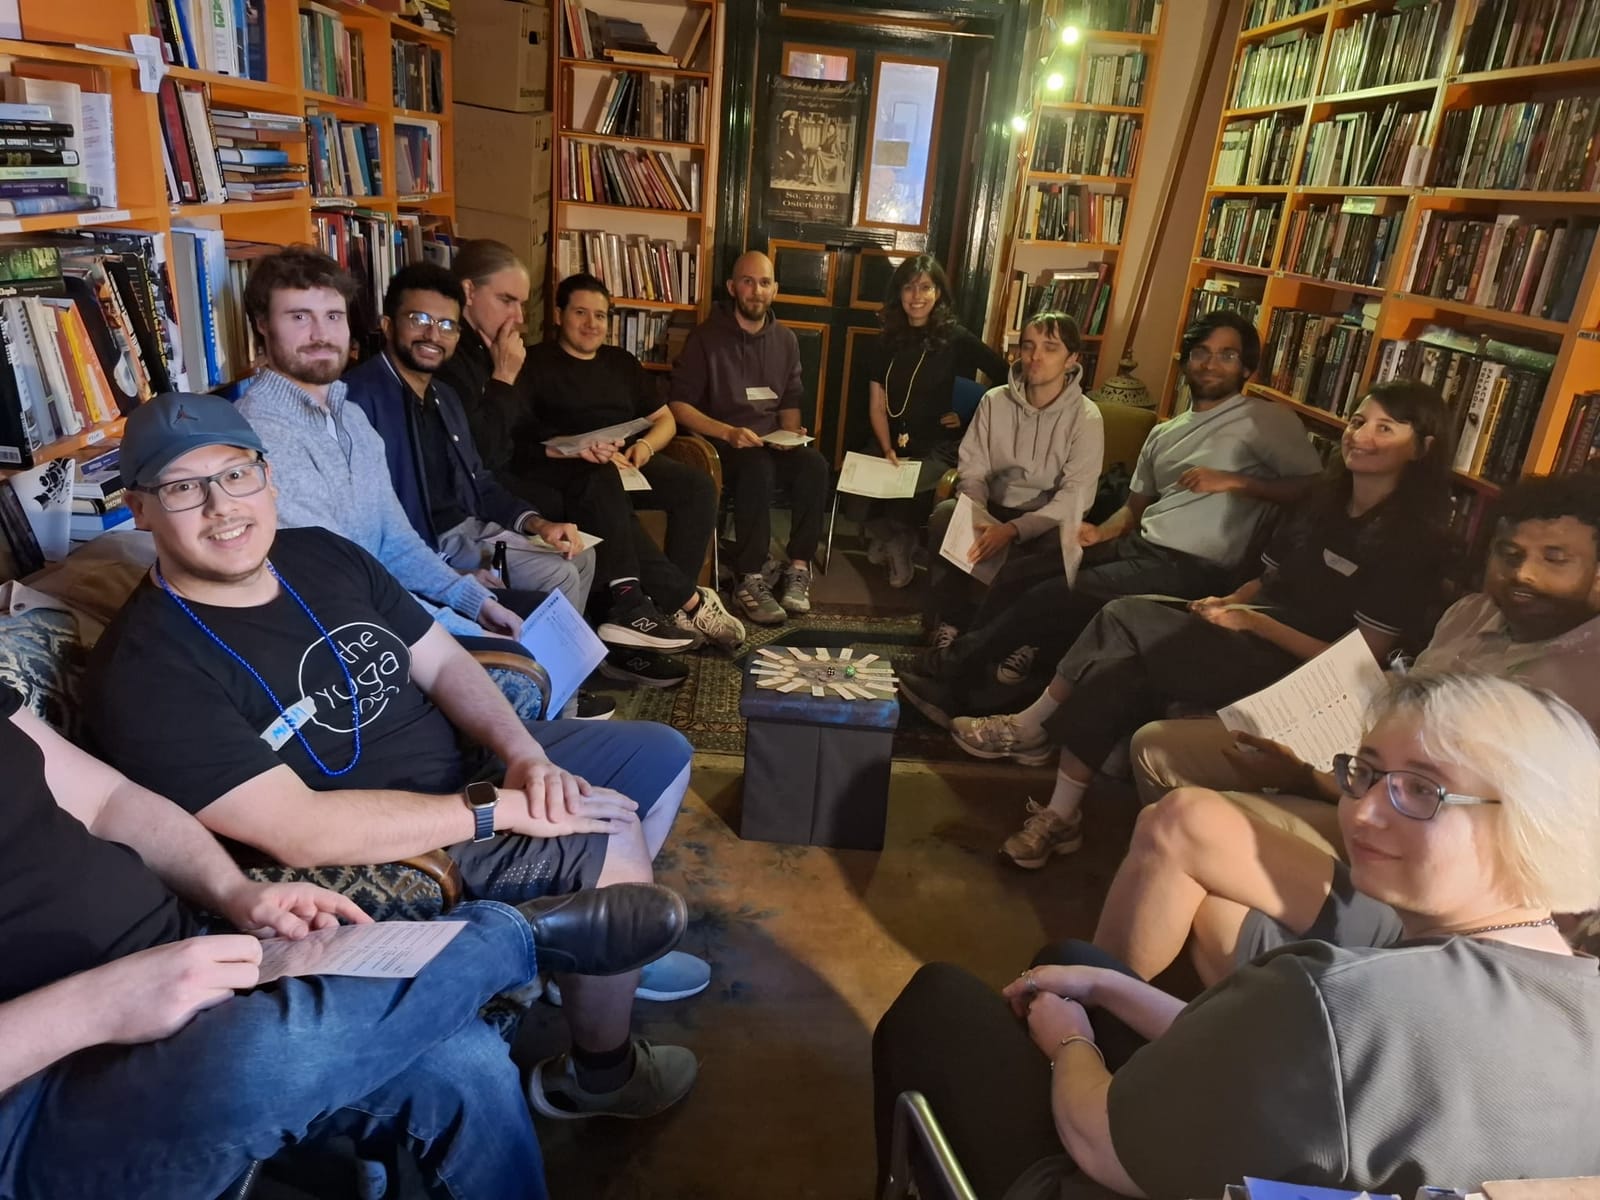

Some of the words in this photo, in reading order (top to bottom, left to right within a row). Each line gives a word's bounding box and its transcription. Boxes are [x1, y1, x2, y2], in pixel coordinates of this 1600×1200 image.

[1471, 367, 1487, 409] TREASON
[1480, 368, 1493, 403] PALACE
[337, 631, 379, 664] the
